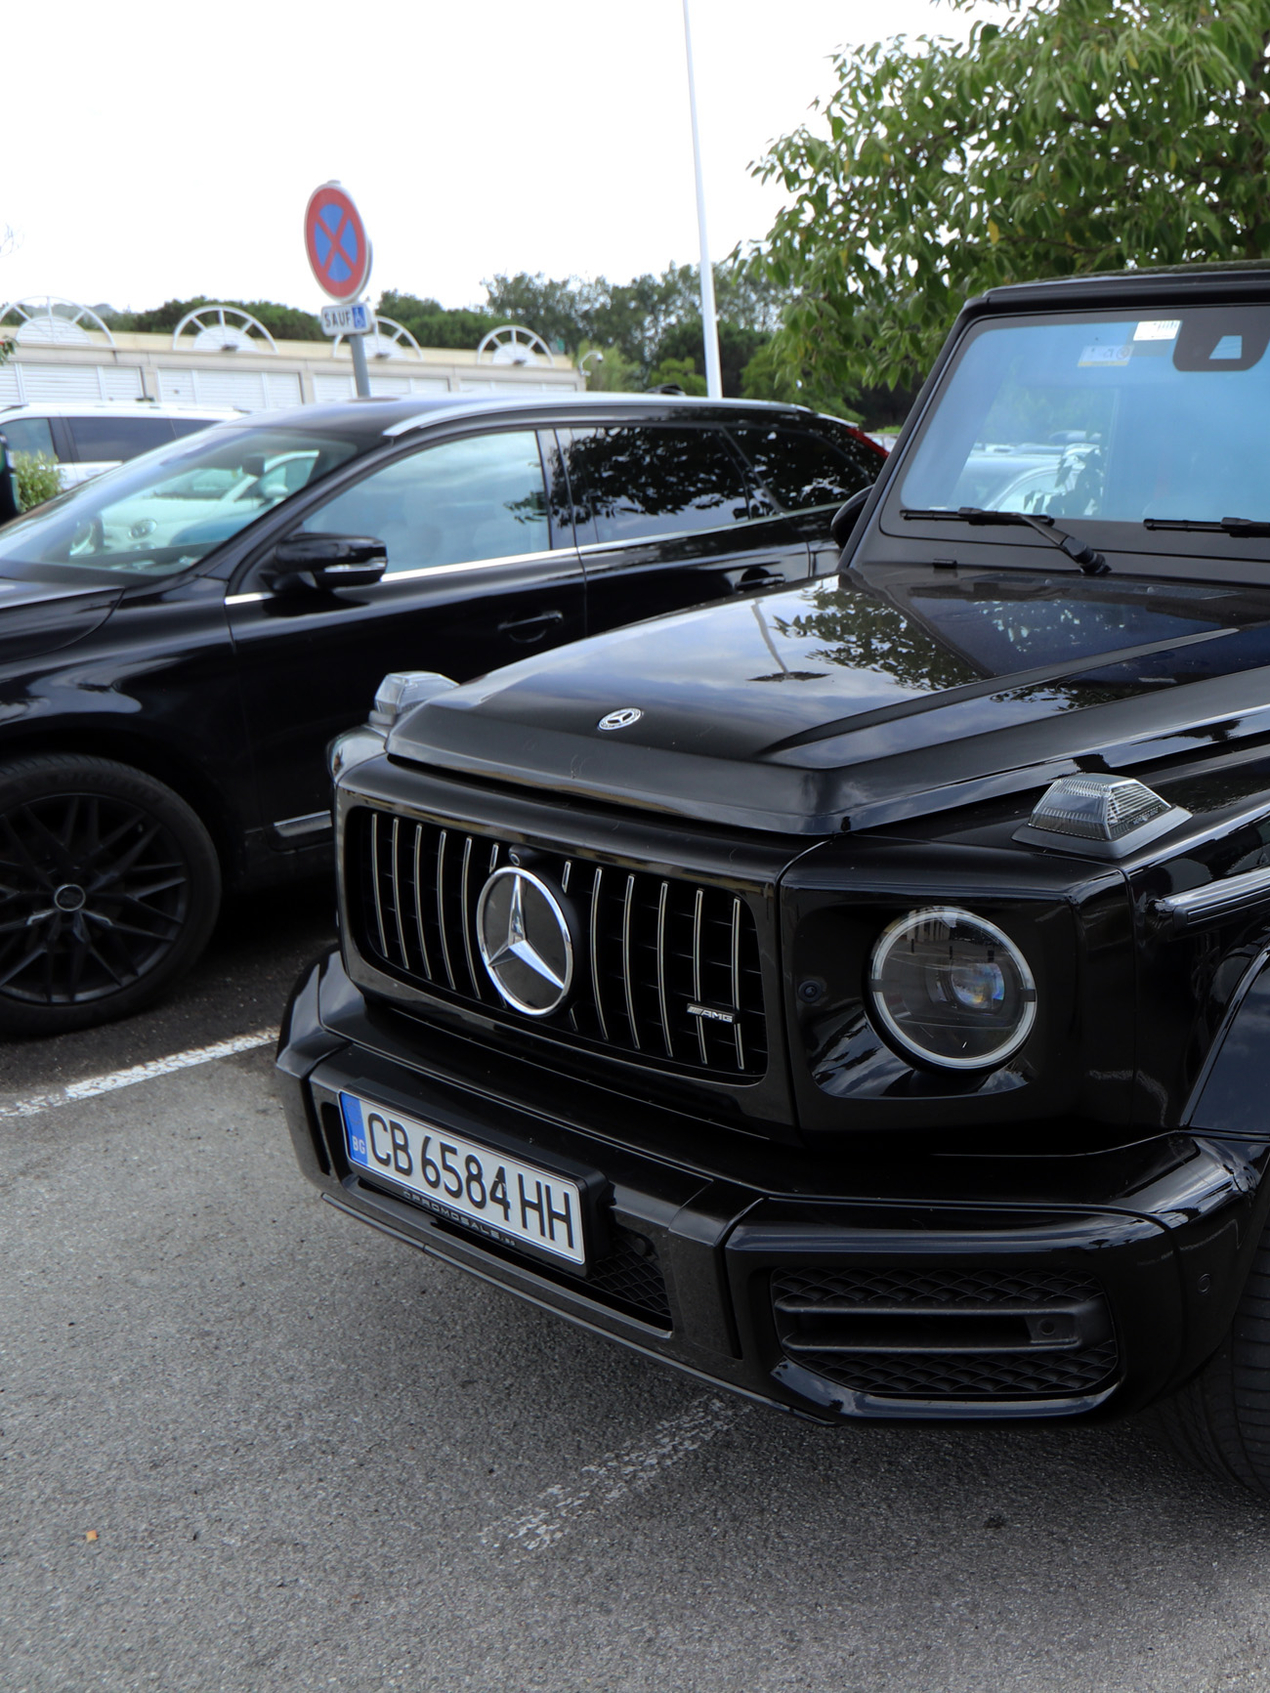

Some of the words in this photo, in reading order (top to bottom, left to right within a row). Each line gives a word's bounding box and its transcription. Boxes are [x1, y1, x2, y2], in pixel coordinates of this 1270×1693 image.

[324, 311, 351, 328] SAUF
[701, 1009, 733, 1022] AMG
[352, 1135, 366, 1155] BG
